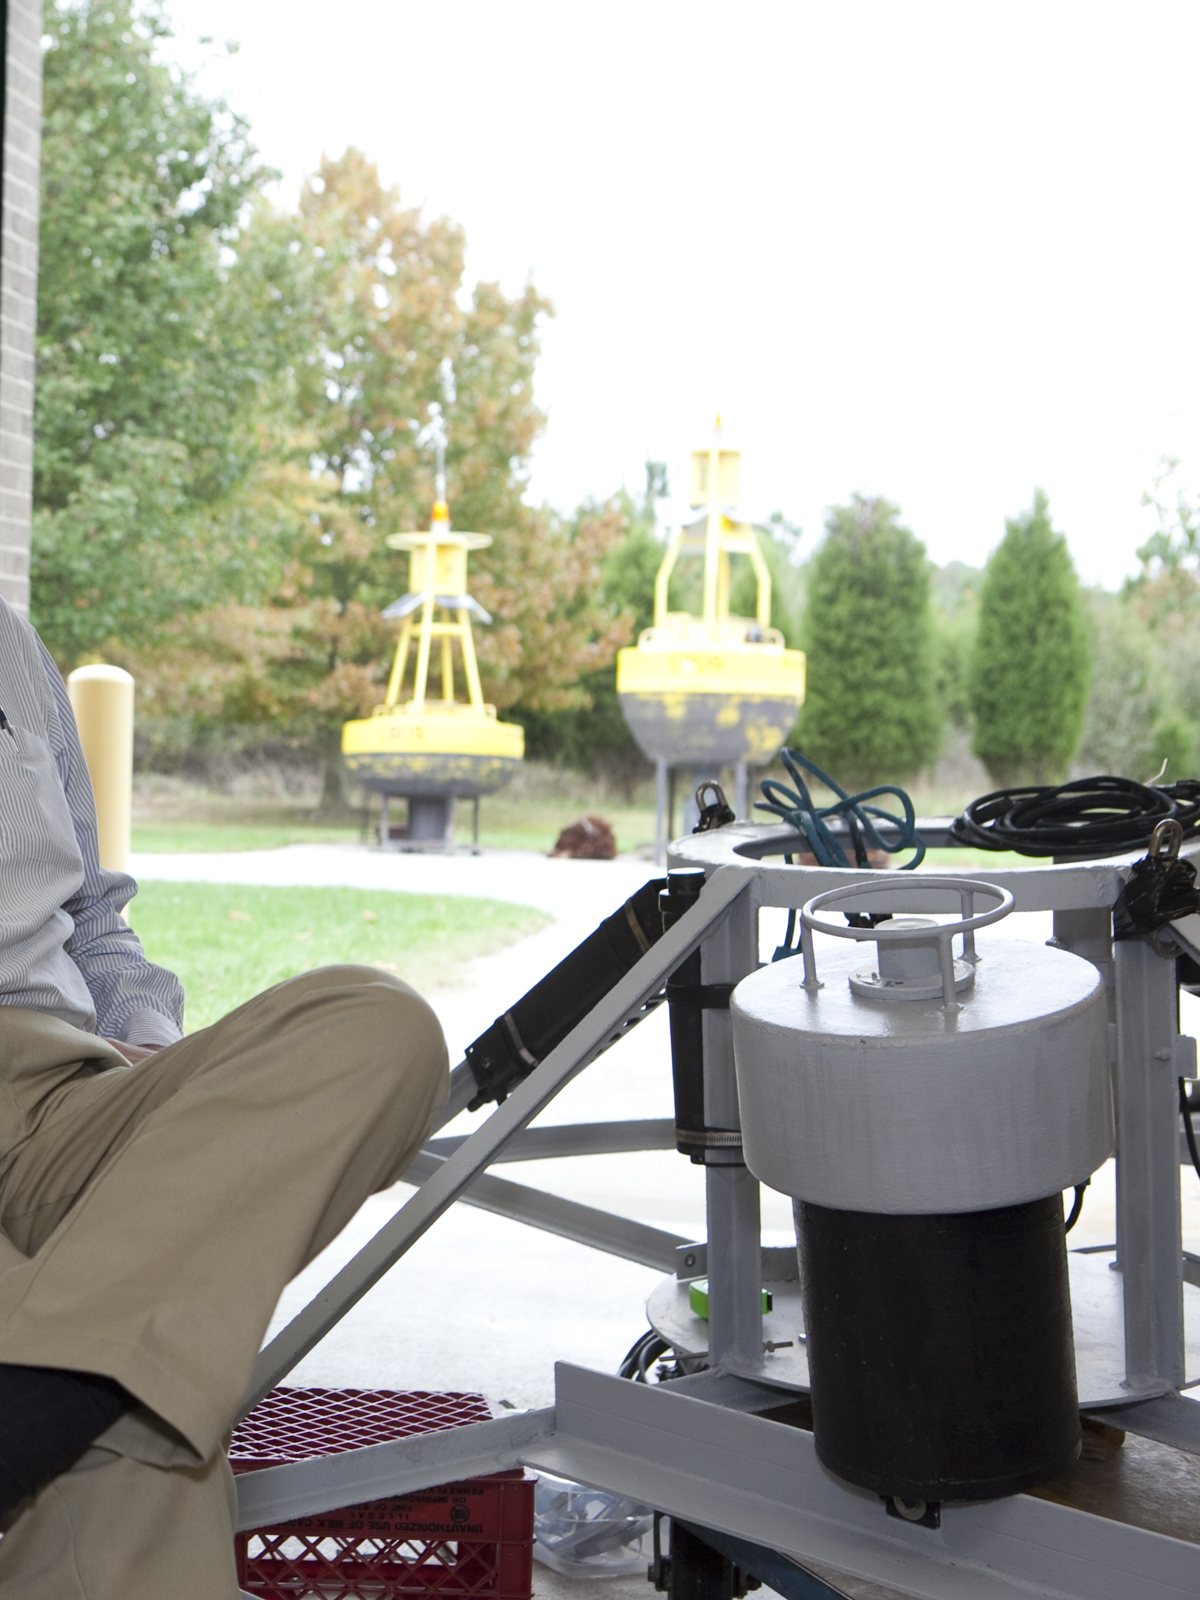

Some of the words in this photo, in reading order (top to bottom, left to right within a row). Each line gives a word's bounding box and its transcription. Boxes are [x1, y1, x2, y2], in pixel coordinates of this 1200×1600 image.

[452, 1496, 466, 1504] OR
[374, 1503, 387, 1511] OF
[318, 1519, 344, 1528] MILK
[349, 1520, 363, 1529] OF
[368, 1521, 390, 1531] USE
[395, 1522, 483, 1533] UNAUTHORIZED
